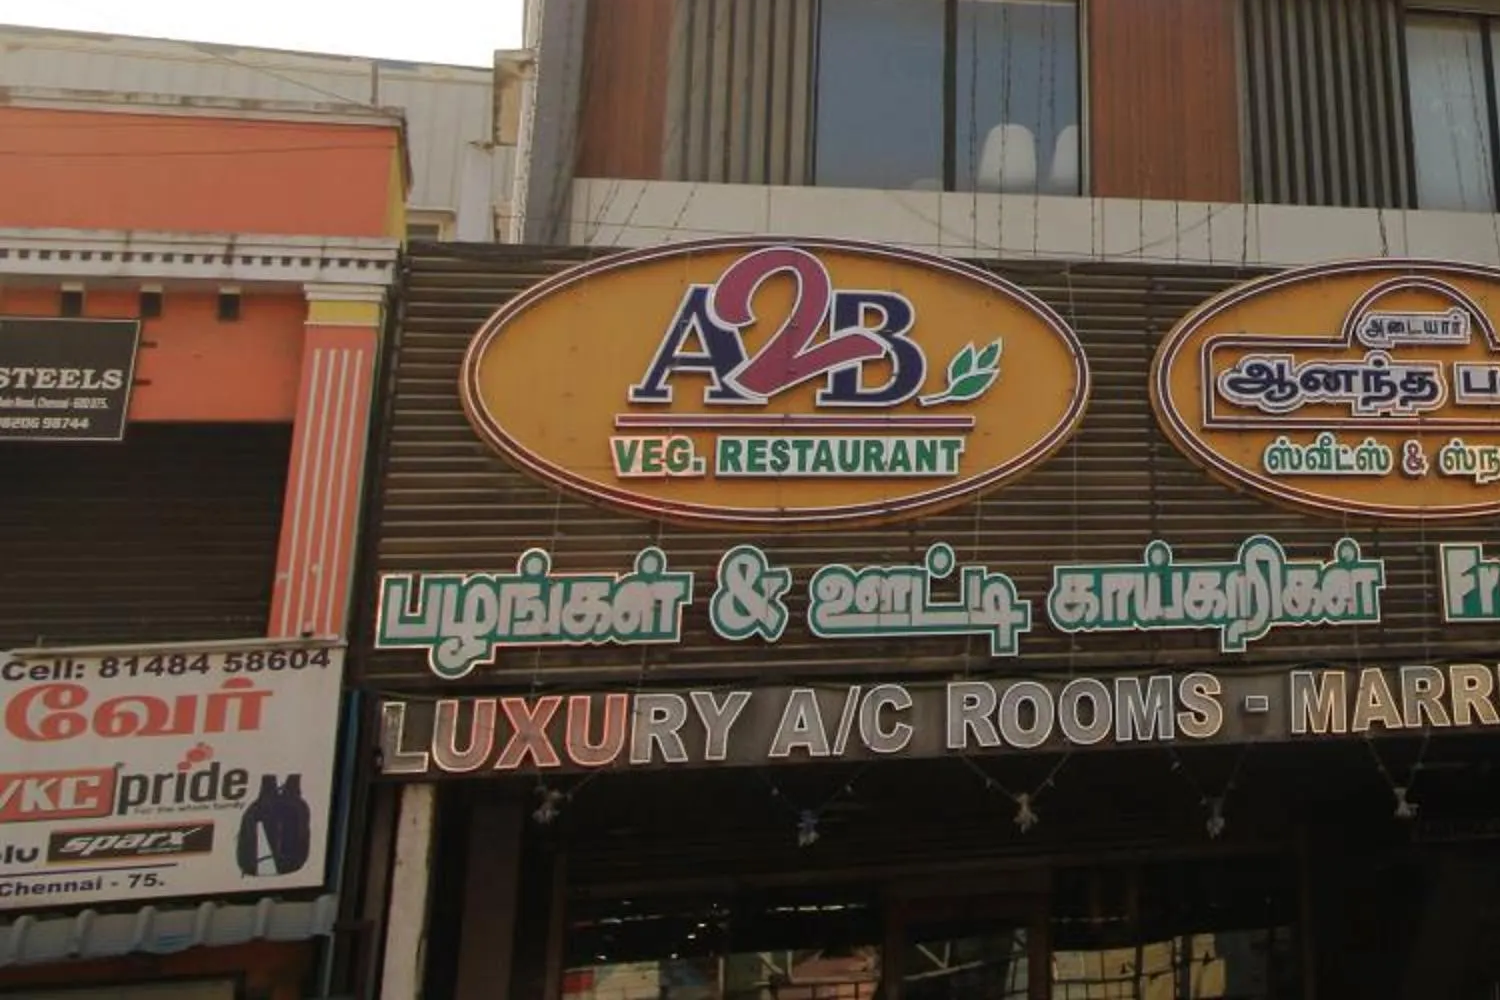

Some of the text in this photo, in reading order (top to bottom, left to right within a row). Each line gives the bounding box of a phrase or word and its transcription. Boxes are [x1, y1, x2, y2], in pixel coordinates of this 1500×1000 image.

[628, 247, 927, 406] A2B
[1364, 313, 1464, 340] அடையார்
[1226, 359, 1439, 407] ஆனந்த
[611, 436, 965, 476] VEG. RESTAURANT
[1403, 440, 1426, 475] &
[376, 548, 692, 677] பழங்கள்
[711, 546, 792, 642] &
[809, 543, 1030, 656] ஊட்டி
[2, 648, 331, 681] Cell: 81484 58604
[382, 690, 752, 774] LUXURY
[769, 684, 912, 757] A/C
[947, 673, 1223, 749] ROOMS
[117, 761, 249, 815] pride
[0, 876, 102, 897] Chennai
[128, 873, 165, 889] 75.
